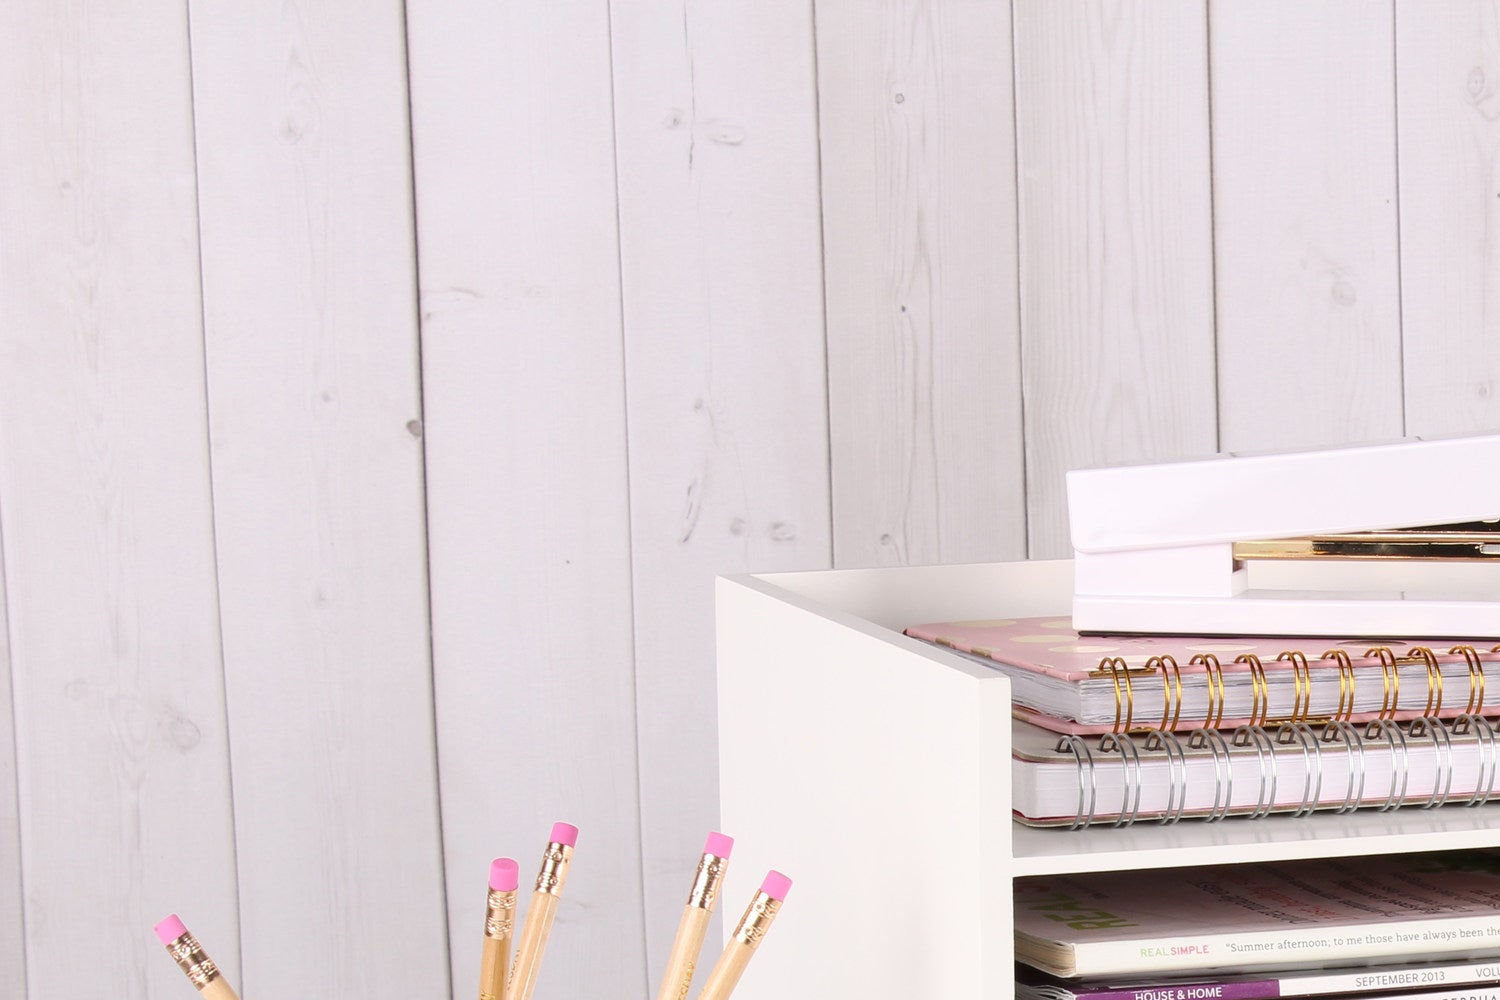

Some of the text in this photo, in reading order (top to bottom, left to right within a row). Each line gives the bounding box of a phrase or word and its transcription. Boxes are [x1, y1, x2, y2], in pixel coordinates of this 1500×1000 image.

[1334, 937, 1344, 946] to
[1347, 937, 1363, 945] me
[1365, 934, 1393, 944] those
[1396, 932, 1420, 942] have
[1423, 930, 1457, 942] always
[1459, 927, 1484, 938] been
[1355, 971, 1445, 987] SEPTEMBER 2013
[1177, 990, 1186, 1000] &
[1187, 987, 1223, 999] HOME
